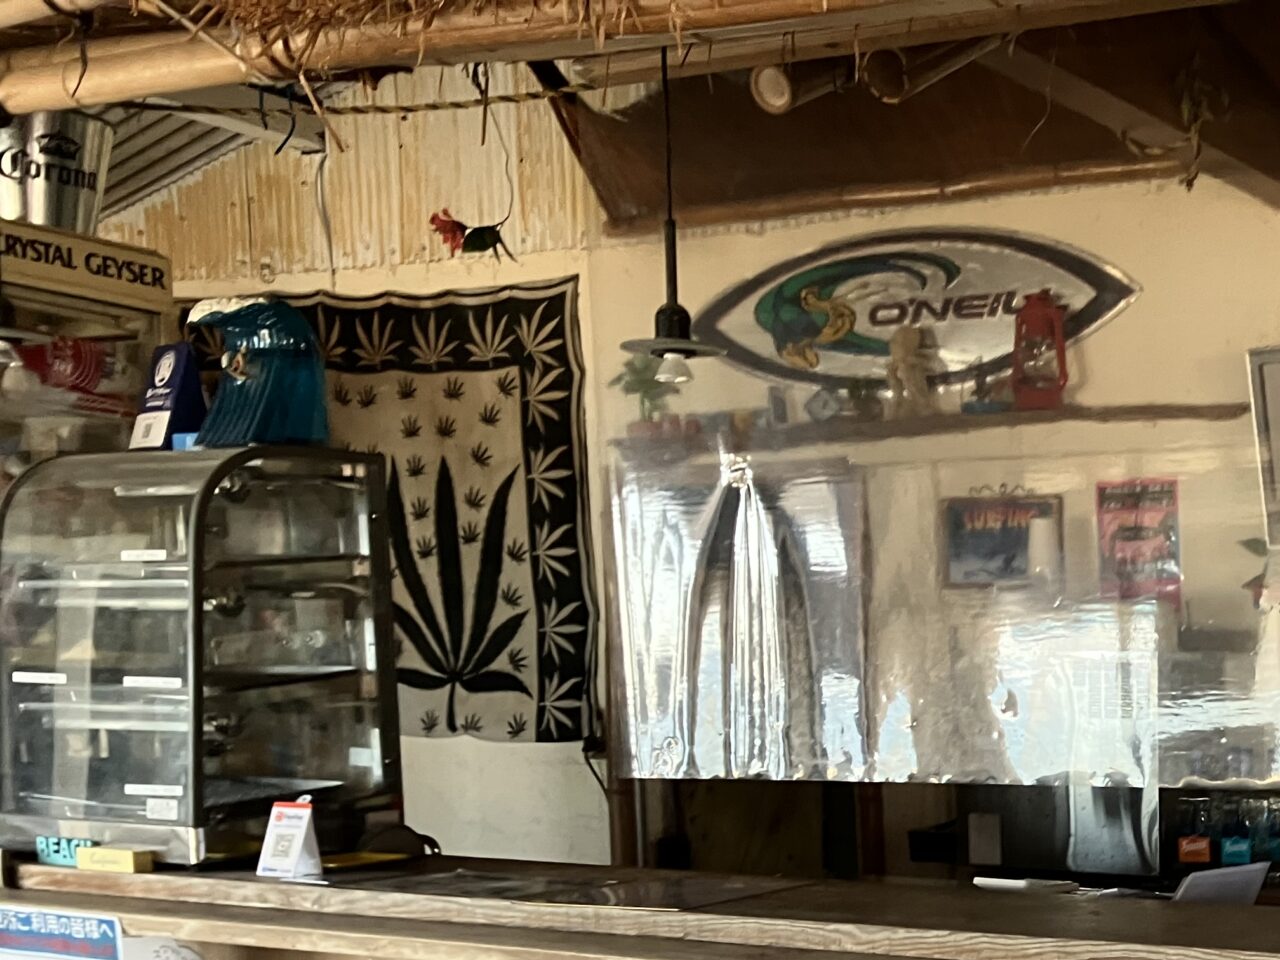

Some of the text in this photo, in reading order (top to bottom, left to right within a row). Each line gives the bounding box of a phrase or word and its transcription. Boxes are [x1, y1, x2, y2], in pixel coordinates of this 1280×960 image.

[0, 146, 97, 192] Corona
[84, 252, 167, 290] GEYSER
[868, 288, 1050, 328] O'NEIL
